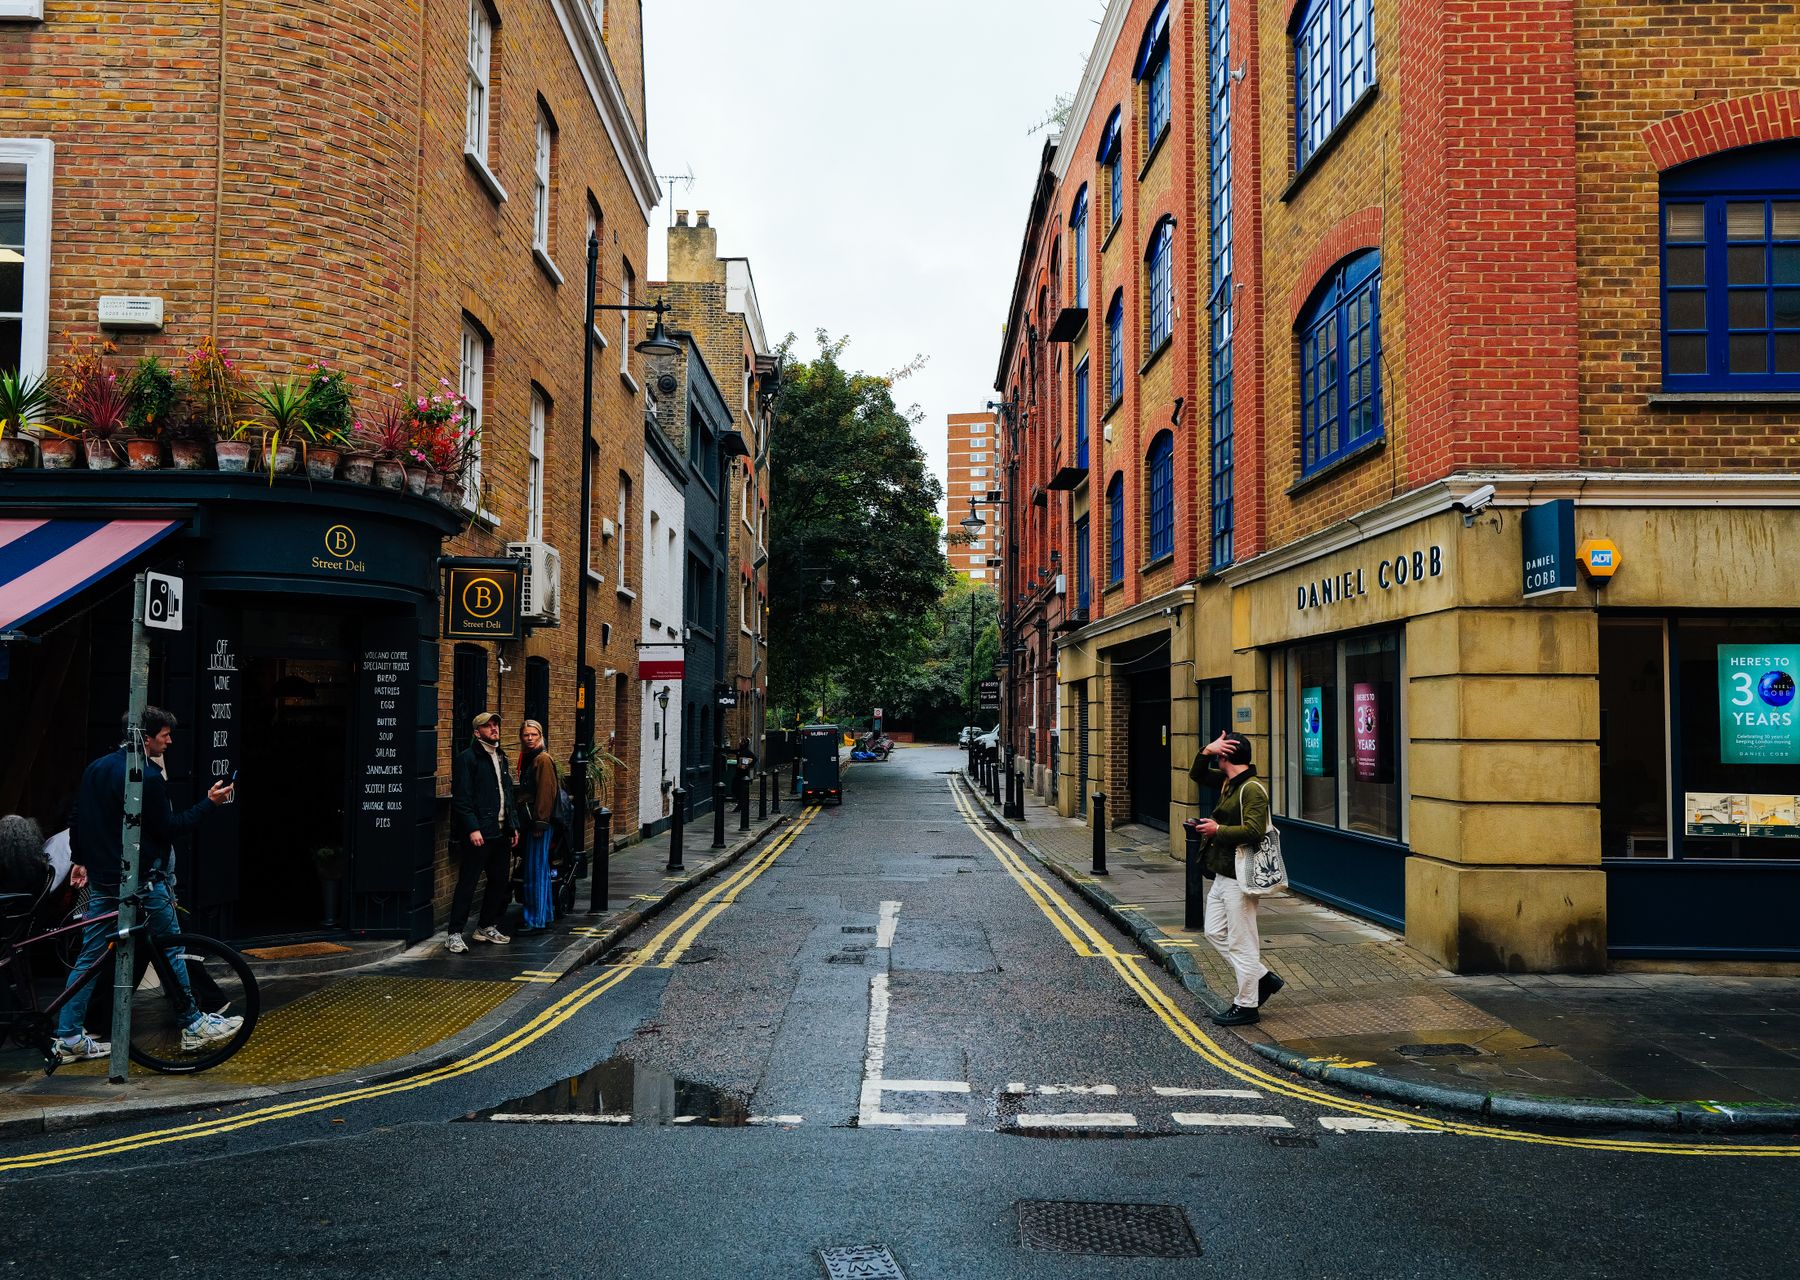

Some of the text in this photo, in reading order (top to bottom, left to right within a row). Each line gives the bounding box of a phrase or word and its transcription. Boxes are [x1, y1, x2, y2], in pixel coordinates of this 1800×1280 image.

[335, 531, 347, 550] B
[311, 556, 366, 572] Street Deli
[1526, 554, 1555, 571] DANIEL
[1591, 553, 1611, 564] ADT
[1297, 545, 1443, 610] DANIEL COBB
[1526, 569, 1556, 589] COBB
[475, 586, 492, 609] B
[463, 619, 501, 629] Street Deli
[216, 639, 228, 654] OFF
[210, 653, 236, 669] LICENCE
[1729, 657, 1790, 667] HERE'S TO
[213, 675, 231, 691] WINE
[377, 674, 397, 682] BREAD
[374, 686, 400, 696] PASTRIES
[380, 700, 395, 709] EGGS
[376, 717, 397, 726] BUTTER
[1732, 712, 1792, 726] YEARS
[213, 730, 228, 747] BEER
[379, 731, 394, 741] SOUP
[1305, 737, 1319, 748] YEARS
[1358, 739, 1376, 751] YEARS
[375, 747, 397, 757] SALADS
[211, 759, 229, 776] CIDER
[366, 765, 403, 775] SANDWICHES
[364, 783, 403, 794] SCOTCH EGGS
[362, 801, 403, 811] SAUSAGE ROLLS
[375, 817, 391, 828] PIES
